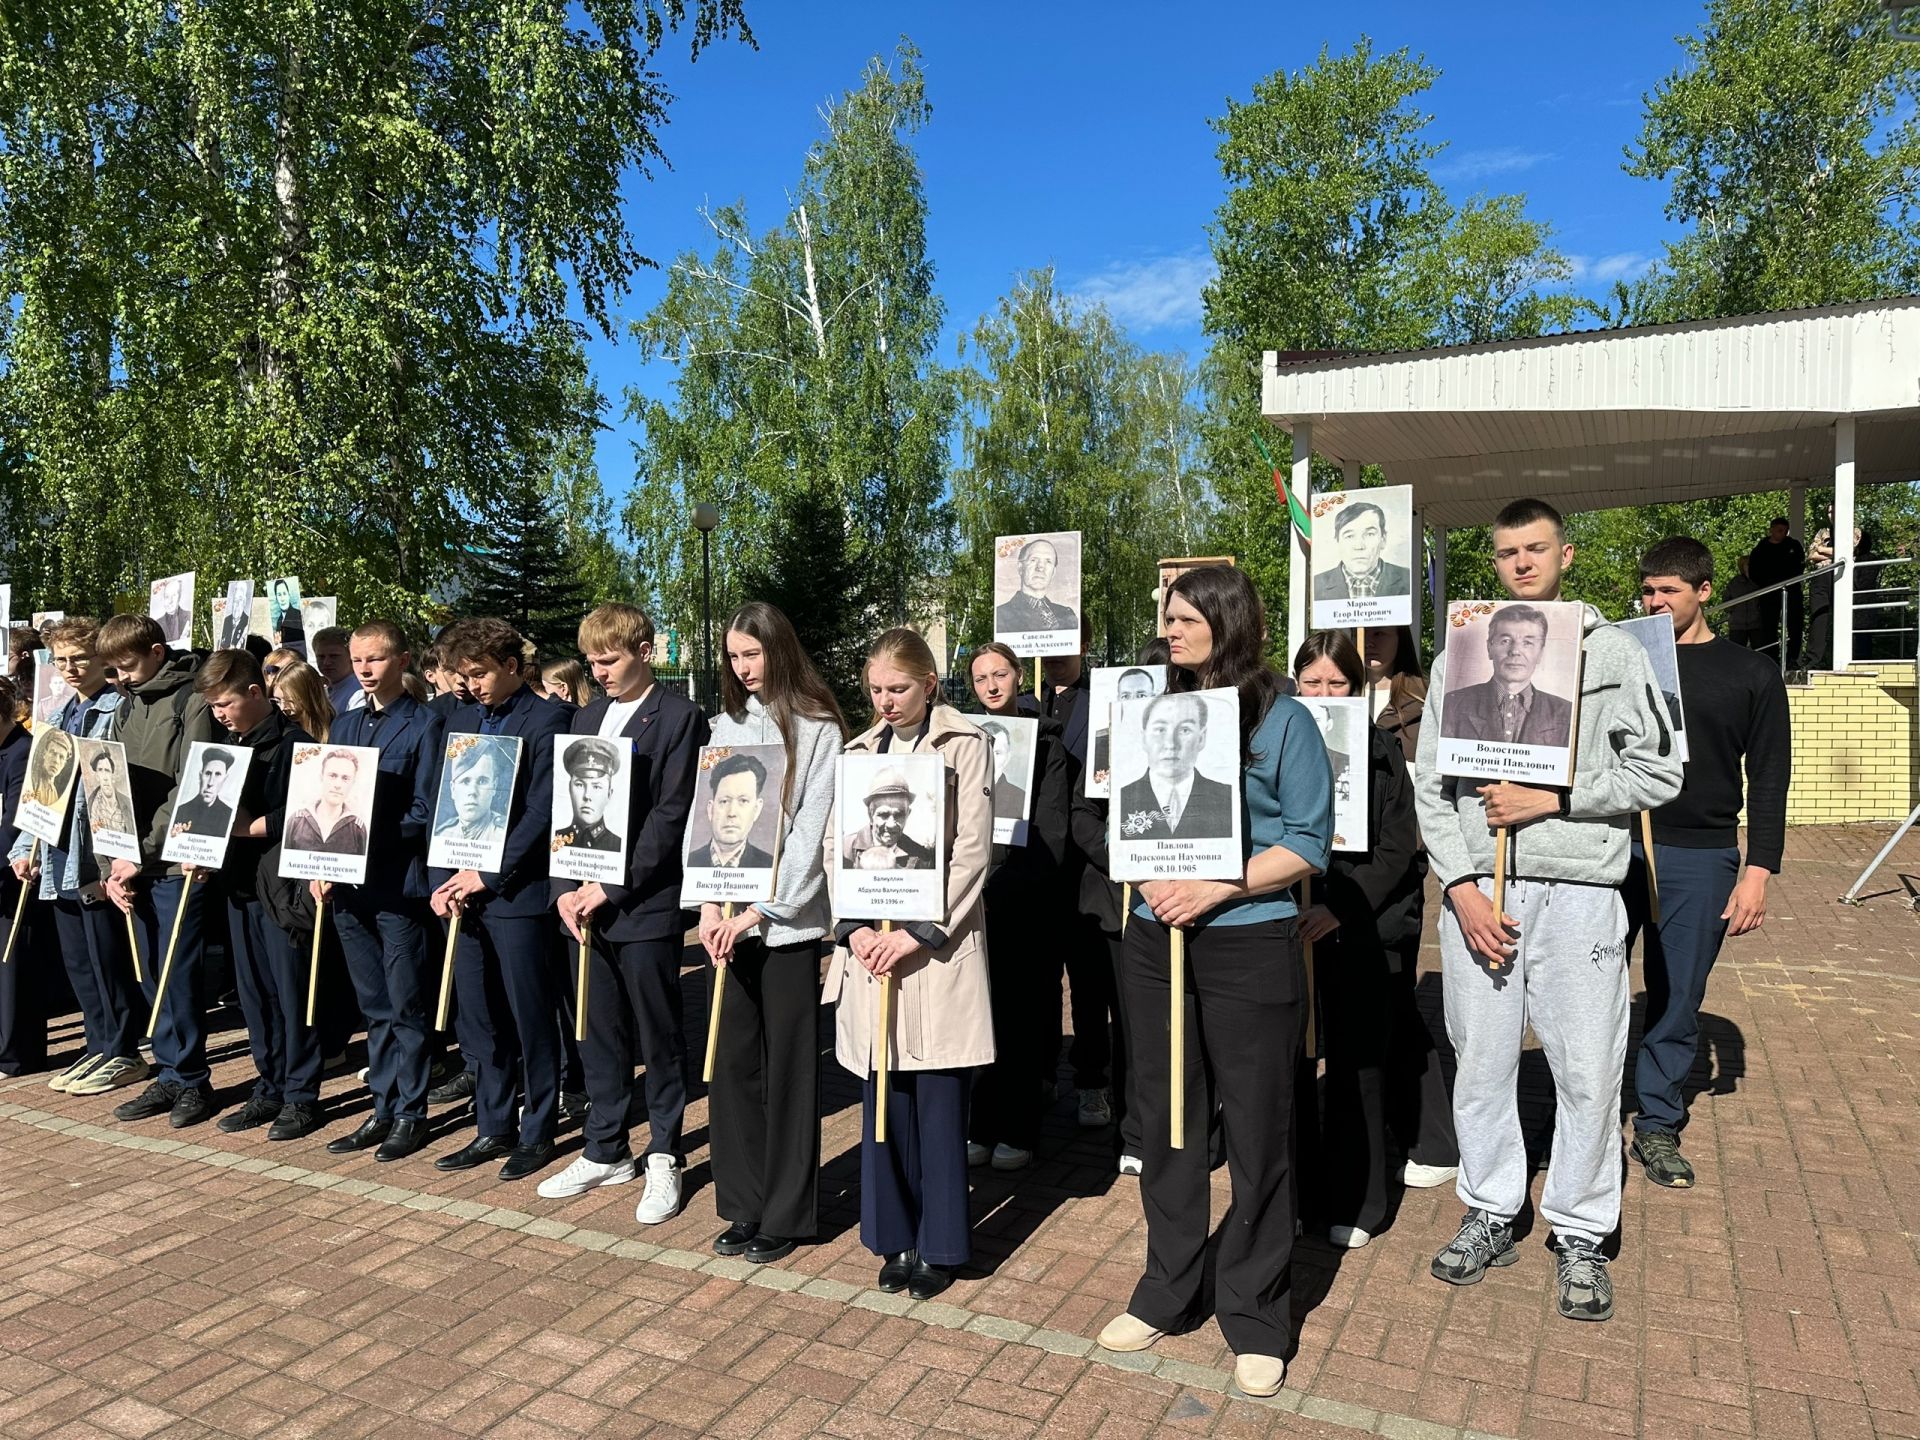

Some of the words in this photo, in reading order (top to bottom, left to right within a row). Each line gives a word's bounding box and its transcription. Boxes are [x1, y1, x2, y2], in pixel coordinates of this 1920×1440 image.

[1347, 600, 1378, 609] Марков
[1333, 611, 1351, 619] Егор
[1353, 609, 1392, 618] Петрович
[1476, 743, 1531, 756] Волостнов
[1451, 753, 1500, 766] Григорий
[1503, 758, 1555, 771] Павлович
[1157, 841, 1194, 850] Павлова
[308, 853, 339, 862] Горюнов
[1130, 853, 1176, 864] Прасковья
[1178, 853, 1222, 863] Наумовна
[288, 861, 320, 870] Анатолий
[322, 864, 358, 873] Андреевич
[557, 858, 577, 867] Андрей
[1154, 864, 1197, 873] 08.10.1905
[696, 881, 722, 890] Виктор
[723, 881, 759, 890] Иванович
